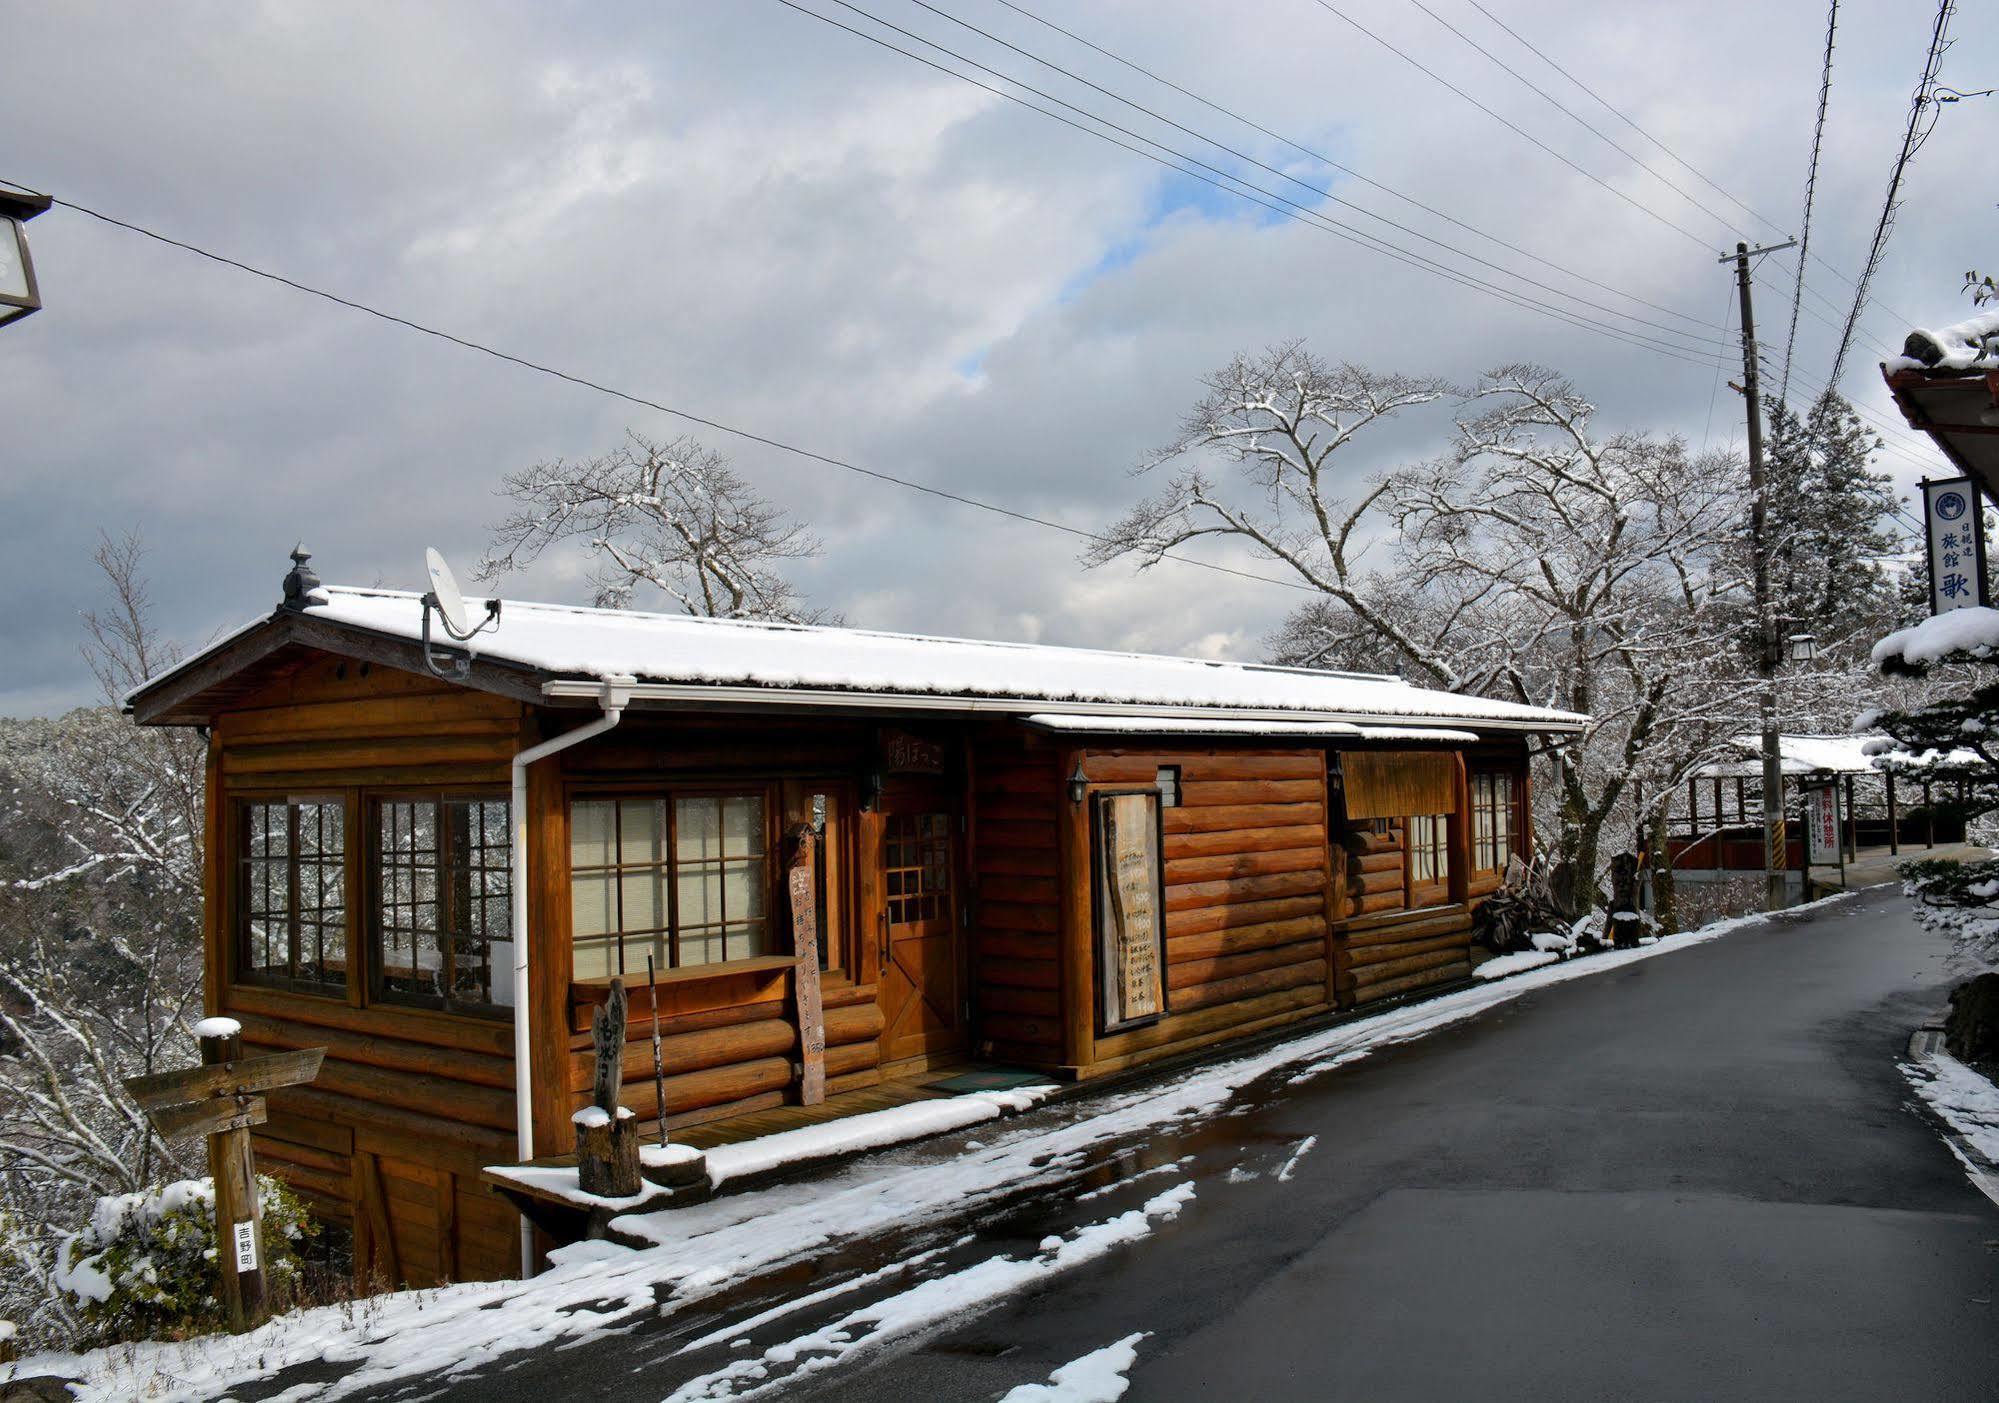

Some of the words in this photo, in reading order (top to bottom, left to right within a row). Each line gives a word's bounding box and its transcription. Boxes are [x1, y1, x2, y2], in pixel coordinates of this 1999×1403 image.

[1940, 533, 1971, 611] 旅館歌
[1823, 787, 1834, 849] 無料休憩所
[238, 1227, 253, 1265] 吉野町
